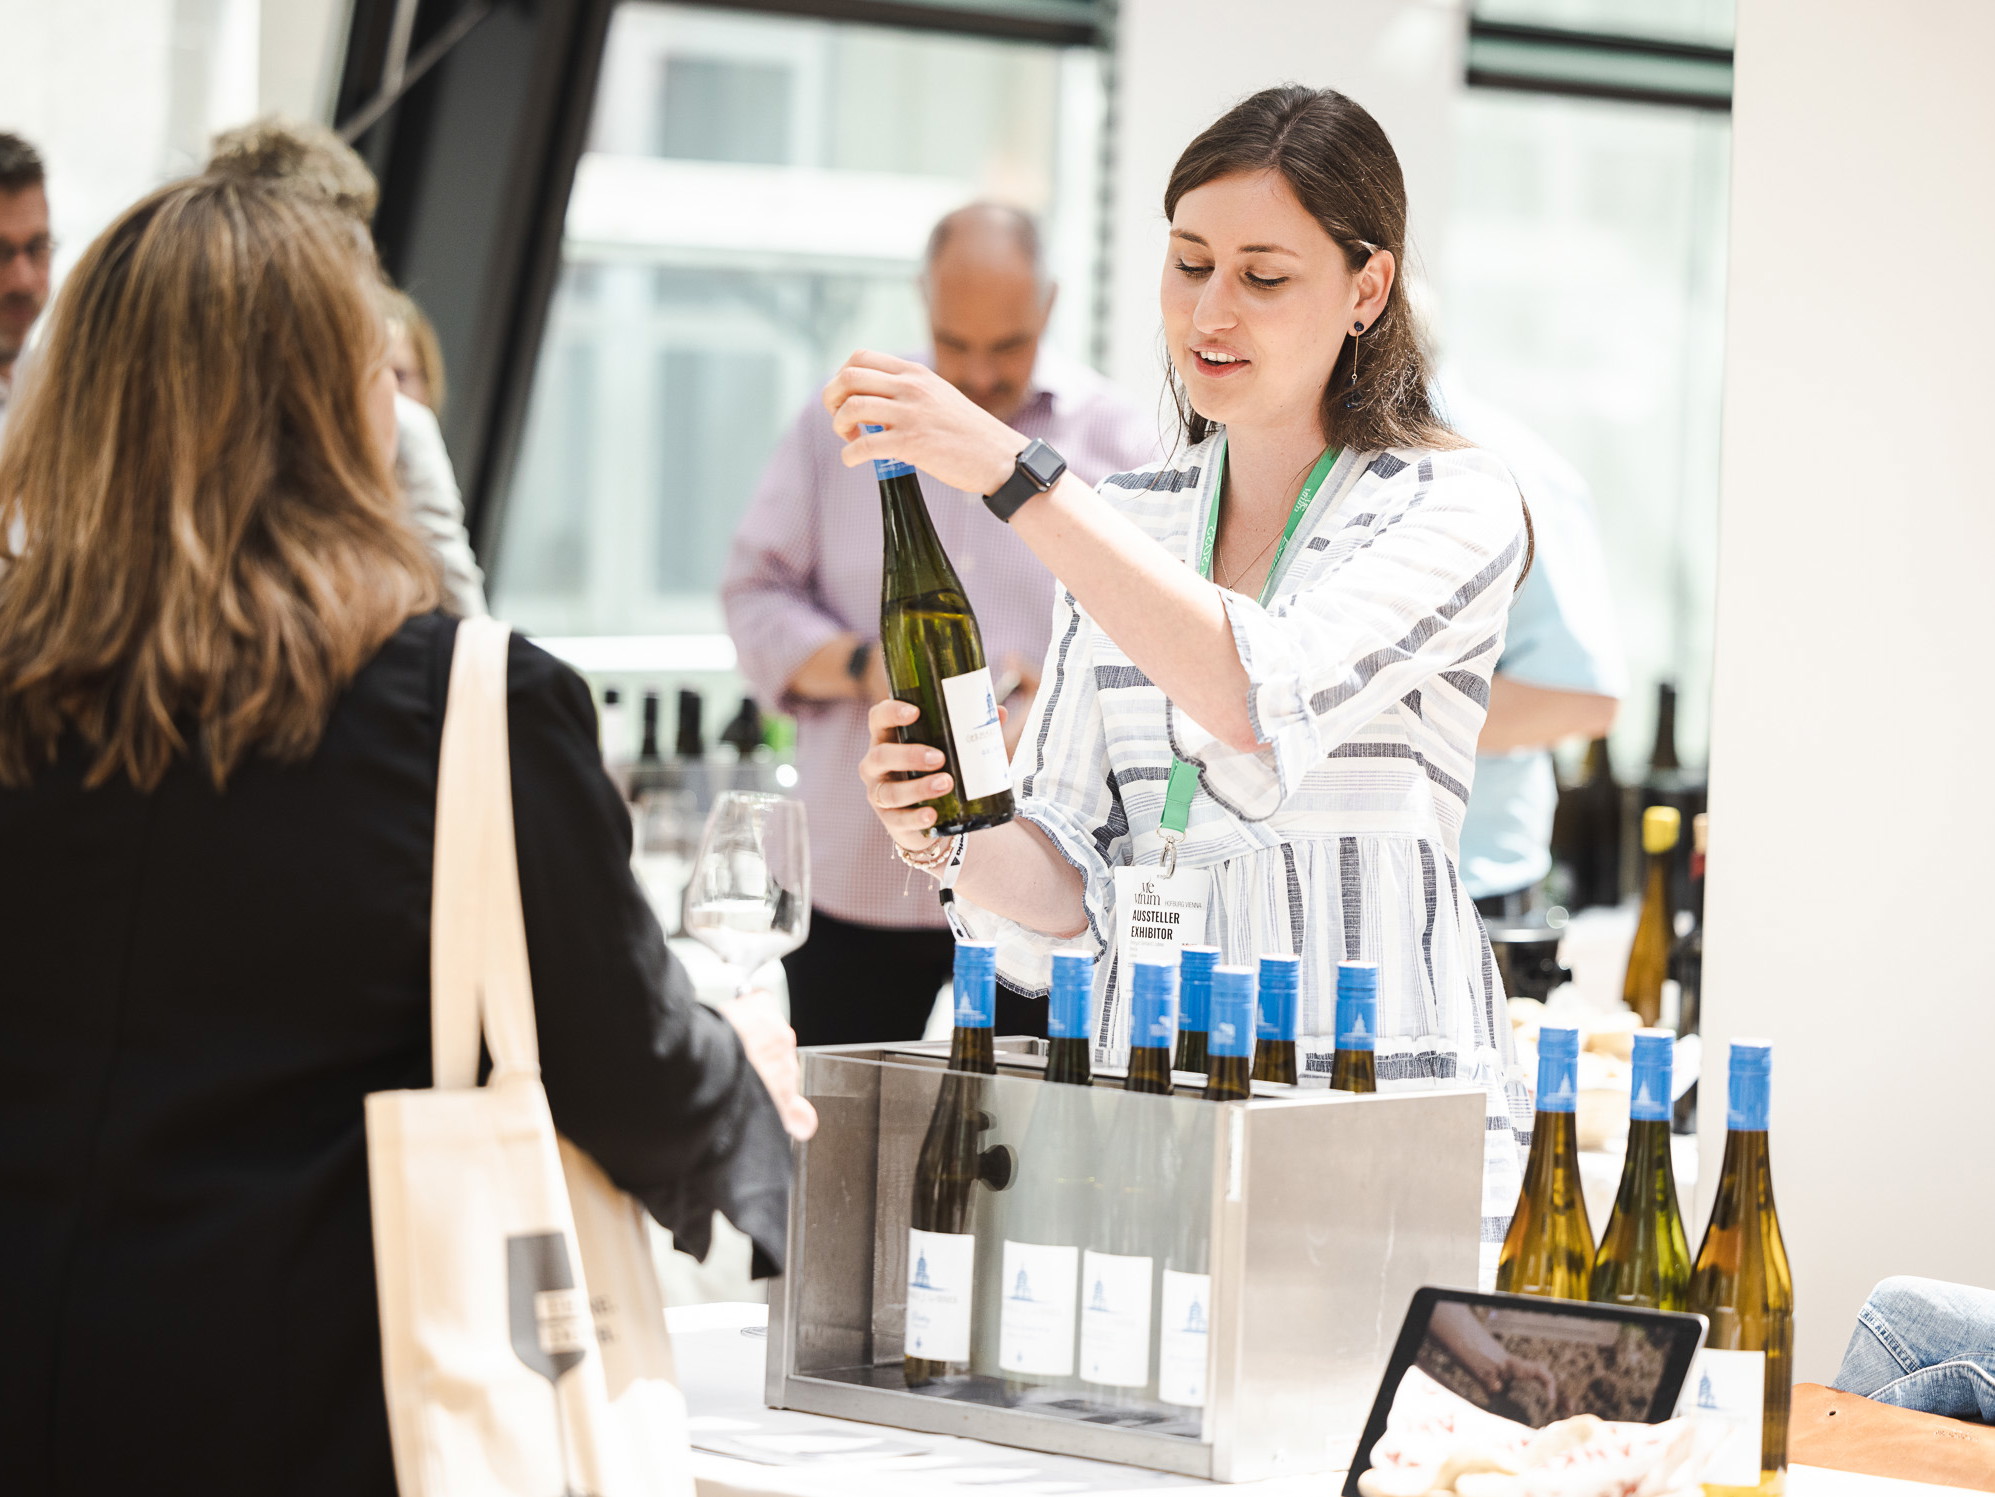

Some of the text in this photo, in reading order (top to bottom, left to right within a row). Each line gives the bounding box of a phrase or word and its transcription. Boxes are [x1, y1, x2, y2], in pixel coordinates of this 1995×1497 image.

[1201, 526, 1215, 566] 2022
[1185, 901, 1202, 909] VIENNA
[1132, 909, 1180, 924] AUSSTELLER
[1131, 926, 1173, 940] EXHIBITOR
